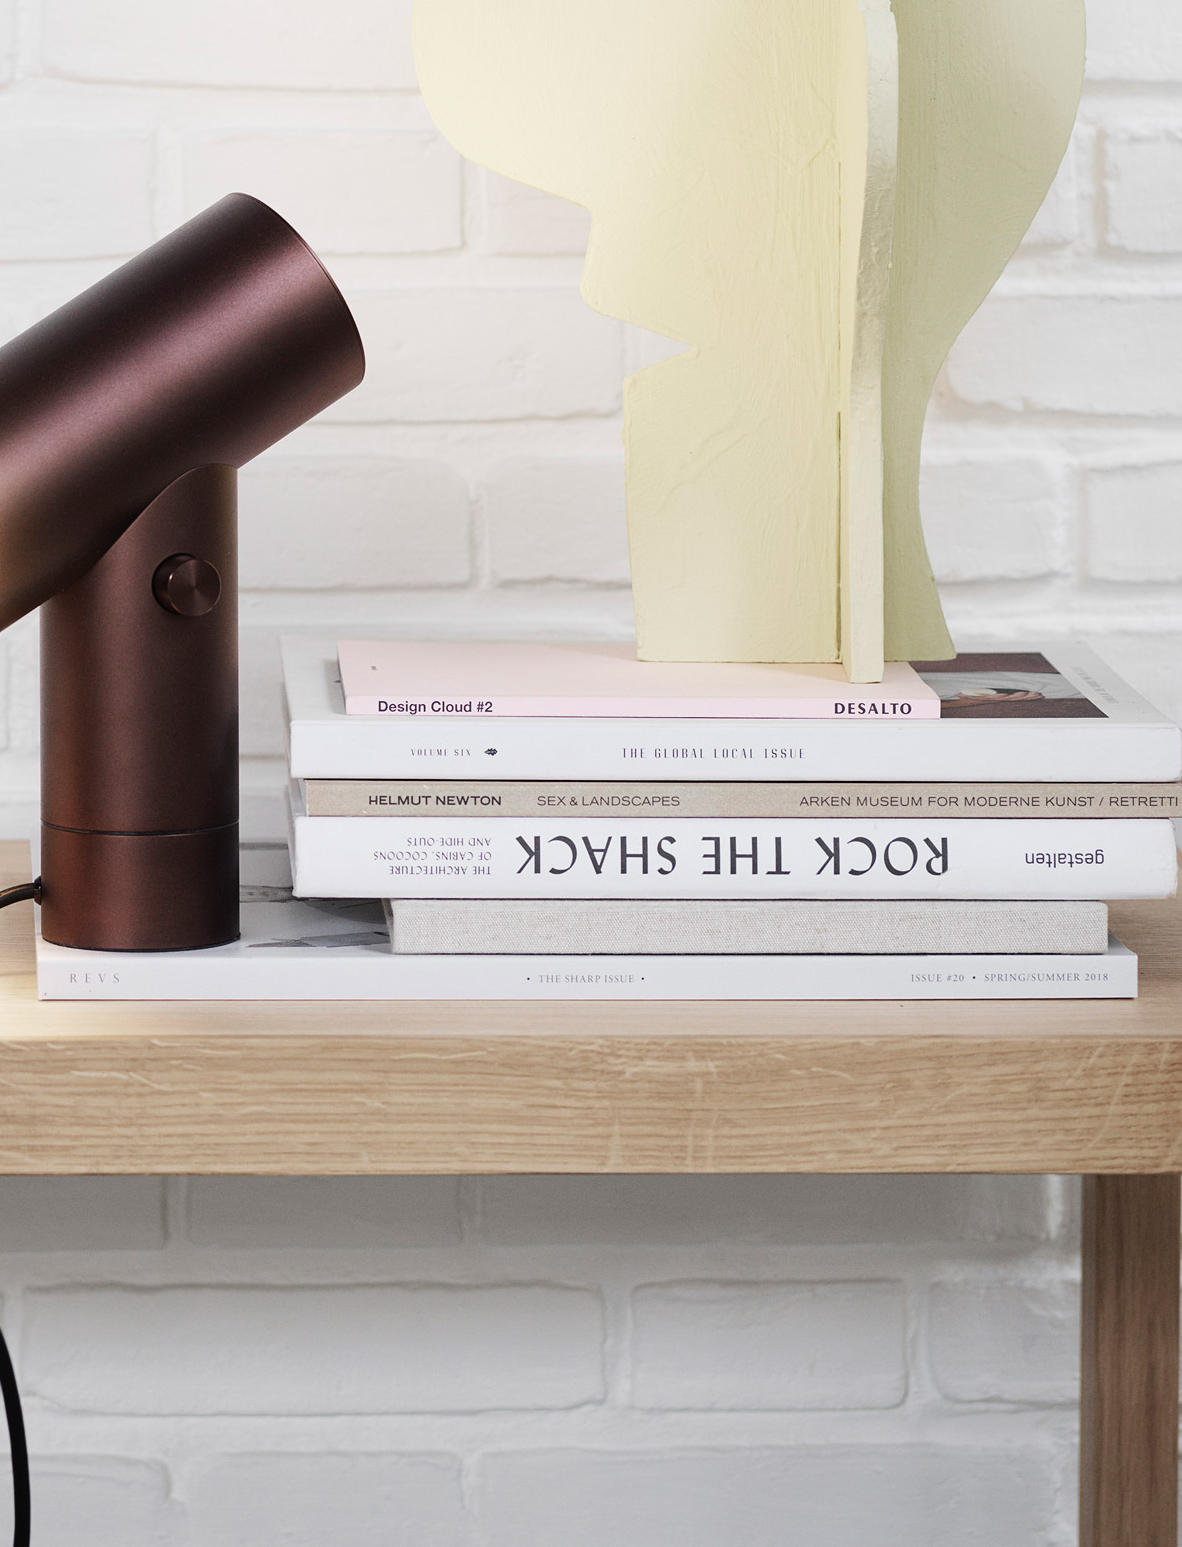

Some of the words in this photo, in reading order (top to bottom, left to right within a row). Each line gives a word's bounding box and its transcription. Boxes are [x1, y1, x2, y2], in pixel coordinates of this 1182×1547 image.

[377, 700, 427, 715] Design
[430, 700, 473, 713] Cloud
[476, 701, 494, 713] #2
[834, 702, 913, 715] DESALTO
[410, 748, 448, 756] VOLUME
[453, 748, 472, 756] SIX
[621, 747, 646, 759] THE
[654, 747, 705, 759] GLOBAL
[713, 747, 754, 759] LOCAL
[763, 747, 806, 759] ISSUE
[368, 794, 432, 806] HELMUT
[435, 794, 502, 806] NEWTON
[537, 795, 567, 807] SEX
[569, 795, 579, 807] &
[581, 795, 681, 807] LANDSCAPES
[799, 796, 851, 807] ARKEN
[856, 796, 923, 807] MUSEUM
[927, 796, 959, 807] FOR
[964, 796, 1041, 807] MODERNE
[1045, 796, 1096, 807] KUNST
[1109, 796, 1179, 807] RETRETTI
[406, 837, 464, 847] HIDE-OUTS
[467, 837, 492, 847] AND
[373, 851, 428, 861] COCOONS
[430, 851, 474, 861] CABINS,
[478, 851, 492, 861] OF
[515, 834, 677, 875] SHACK
[699, 835, 792, 877] THE
[814, 835, 949, 877] ROCK
[1025, 848, 1105, 869] gestalten
[389, 865, 468, 875] ARCHITECTURE
[473, 865, 491, 875] THE
[69, 972, 120, 984] REVS
[538, 974, 562, 983] THE
[564, 974, 601, 983] SHARP
[604, 974, 635, 983] ISSUE
[911, 973, 943, 983] ISSUE
[946, 973, 965, 982] #20
[983, 972, 1081, 983] SPRING/SUMMER
[1084, 972, 1109, 982] 2018
